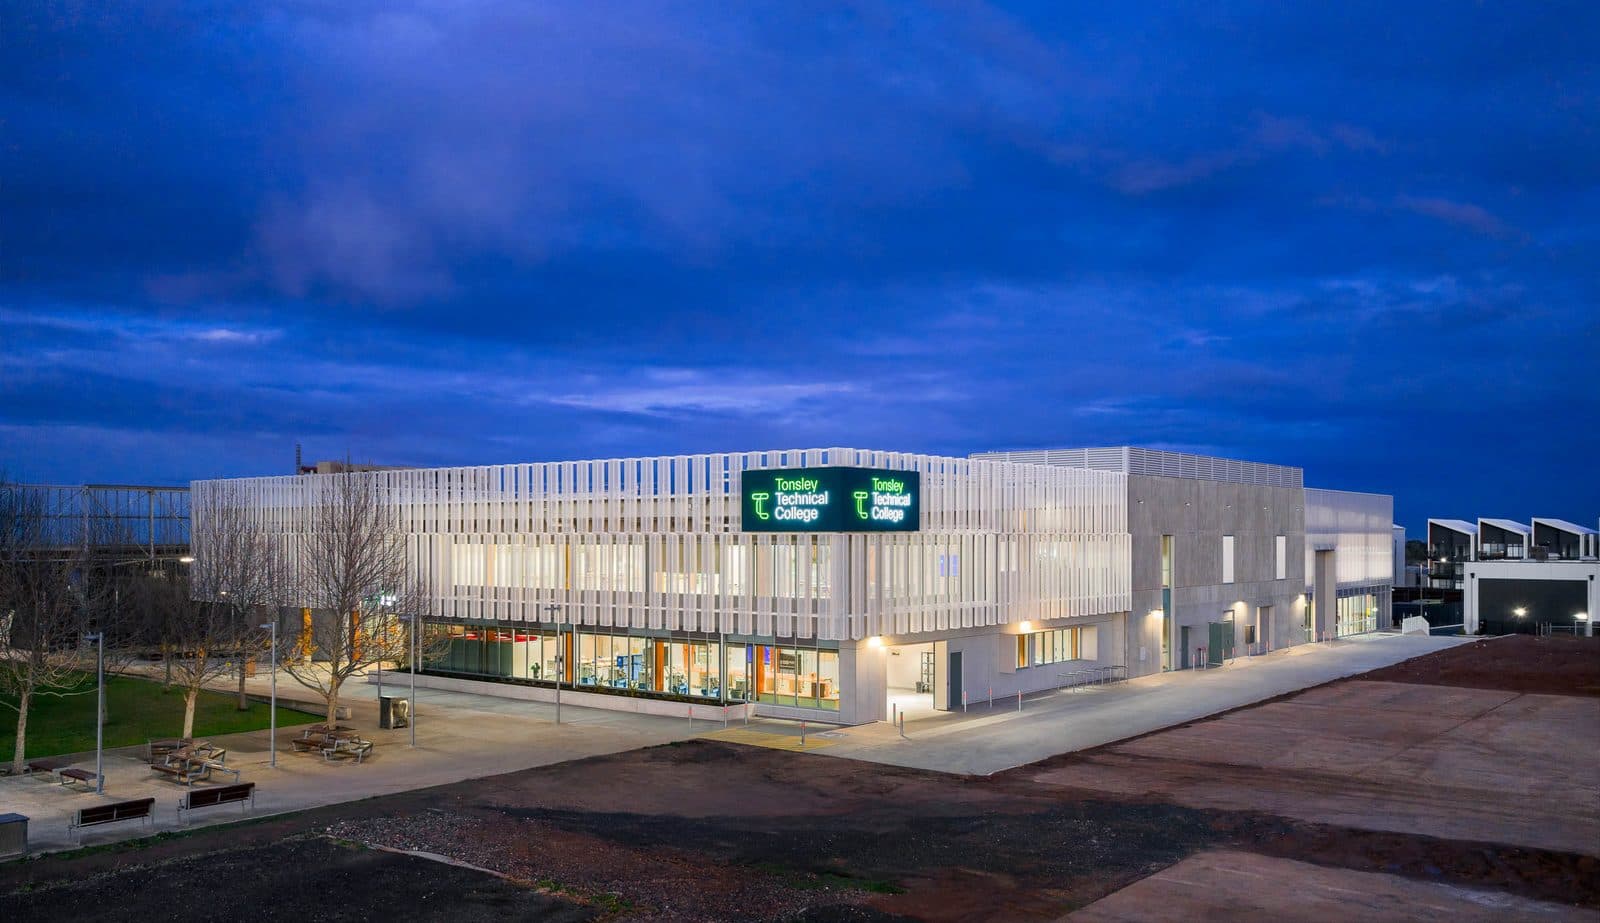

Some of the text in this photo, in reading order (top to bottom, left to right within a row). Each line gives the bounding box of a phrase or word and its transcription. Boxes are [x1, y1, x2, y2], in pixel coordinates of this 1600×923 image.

[775, 478, 818, 492] Tonsley
[872, 478, 904, 493] Tonsley
[775, 491, 828, 505] Technical
[872, 492, 911, 505] Technical
[775, 507, 818, 521] College
[872, 507, 904, 522] College
